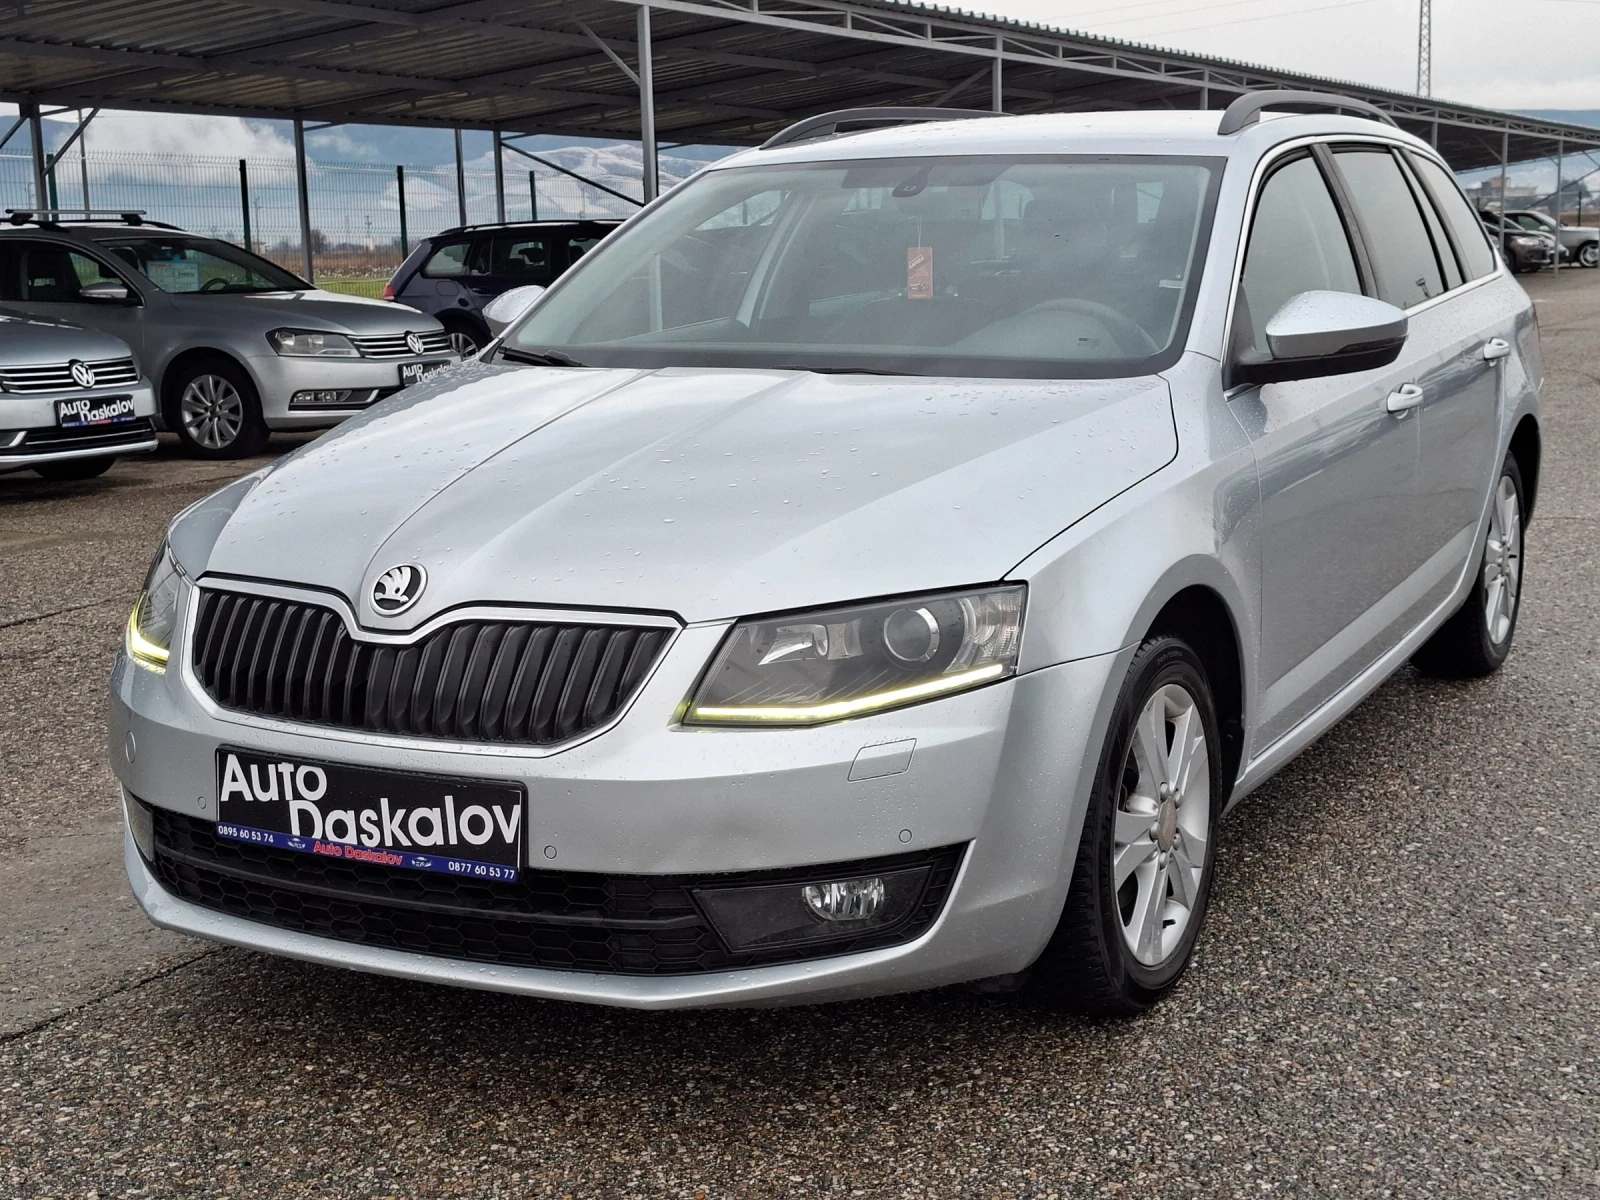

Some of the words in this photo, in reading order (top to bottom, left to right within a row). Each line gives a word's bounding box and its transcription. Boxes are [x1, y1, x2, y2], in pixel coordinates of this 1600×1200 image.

[60, 400, 90, 418] Auto
[80, 399, 134, 422] Daskalov
[220, 754, 328, 802] Auto
[289, 795, 521, 847] Daskalov
[218, 825, 238, 837] 0895
[240, 829, 250, 839] 60
[251, 831, 262, 841] 53
[264, 833, 274, 843] 74
[313, 840, 342, 856] Auto
[345, 845, 403, 865] Daskalov
[448, 861, 472, 873] 0877
[475, 865, 487, 875] 60
[489, 867, 501, 877] 53
[503, 869, 515, 879] 77
